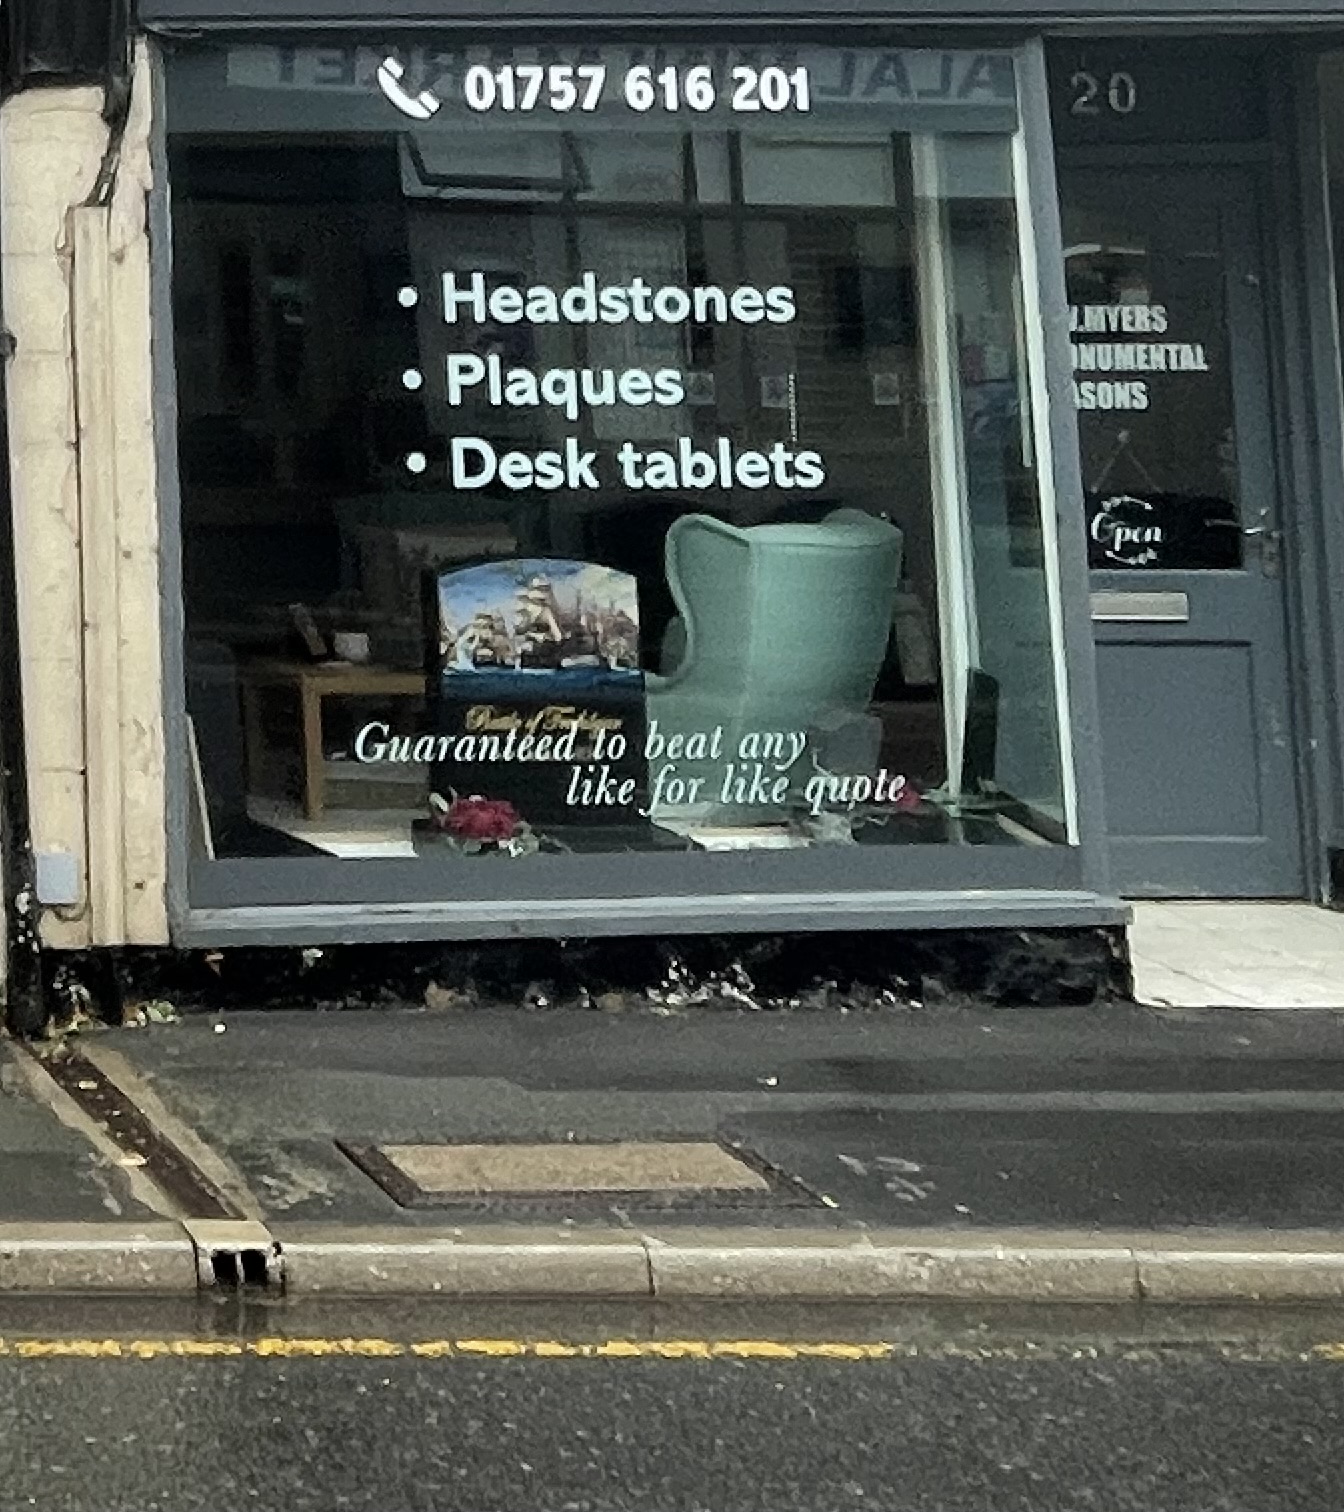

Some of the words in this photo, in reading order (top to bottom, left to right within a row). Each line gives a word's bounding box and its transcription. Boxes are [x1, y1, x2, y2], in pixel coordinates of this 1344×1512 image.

[464, 65, 607, 111] 01757
[624, 65, 715, 111] 616
[730, 66, 811, 111] 201
[1070, 71, 1136, 114] 20
[442, 271, 797, 324] Headstones
[446, 353, 685, 420] Plaques
[450, 437, 600, 490] Desk
[617, 437, 826, 490] tablets
[354, 720, 578, 764] Guaranteed
[592, 726, 628, 761] to
[644, 720, 723, 761] beat
[738, 728, 808, 772] any
[565, 766, 637, 806] like
[639, 766, 707, 816] for
[719, 766, 788, 805] like
[804, 771, 907, 813] quote
